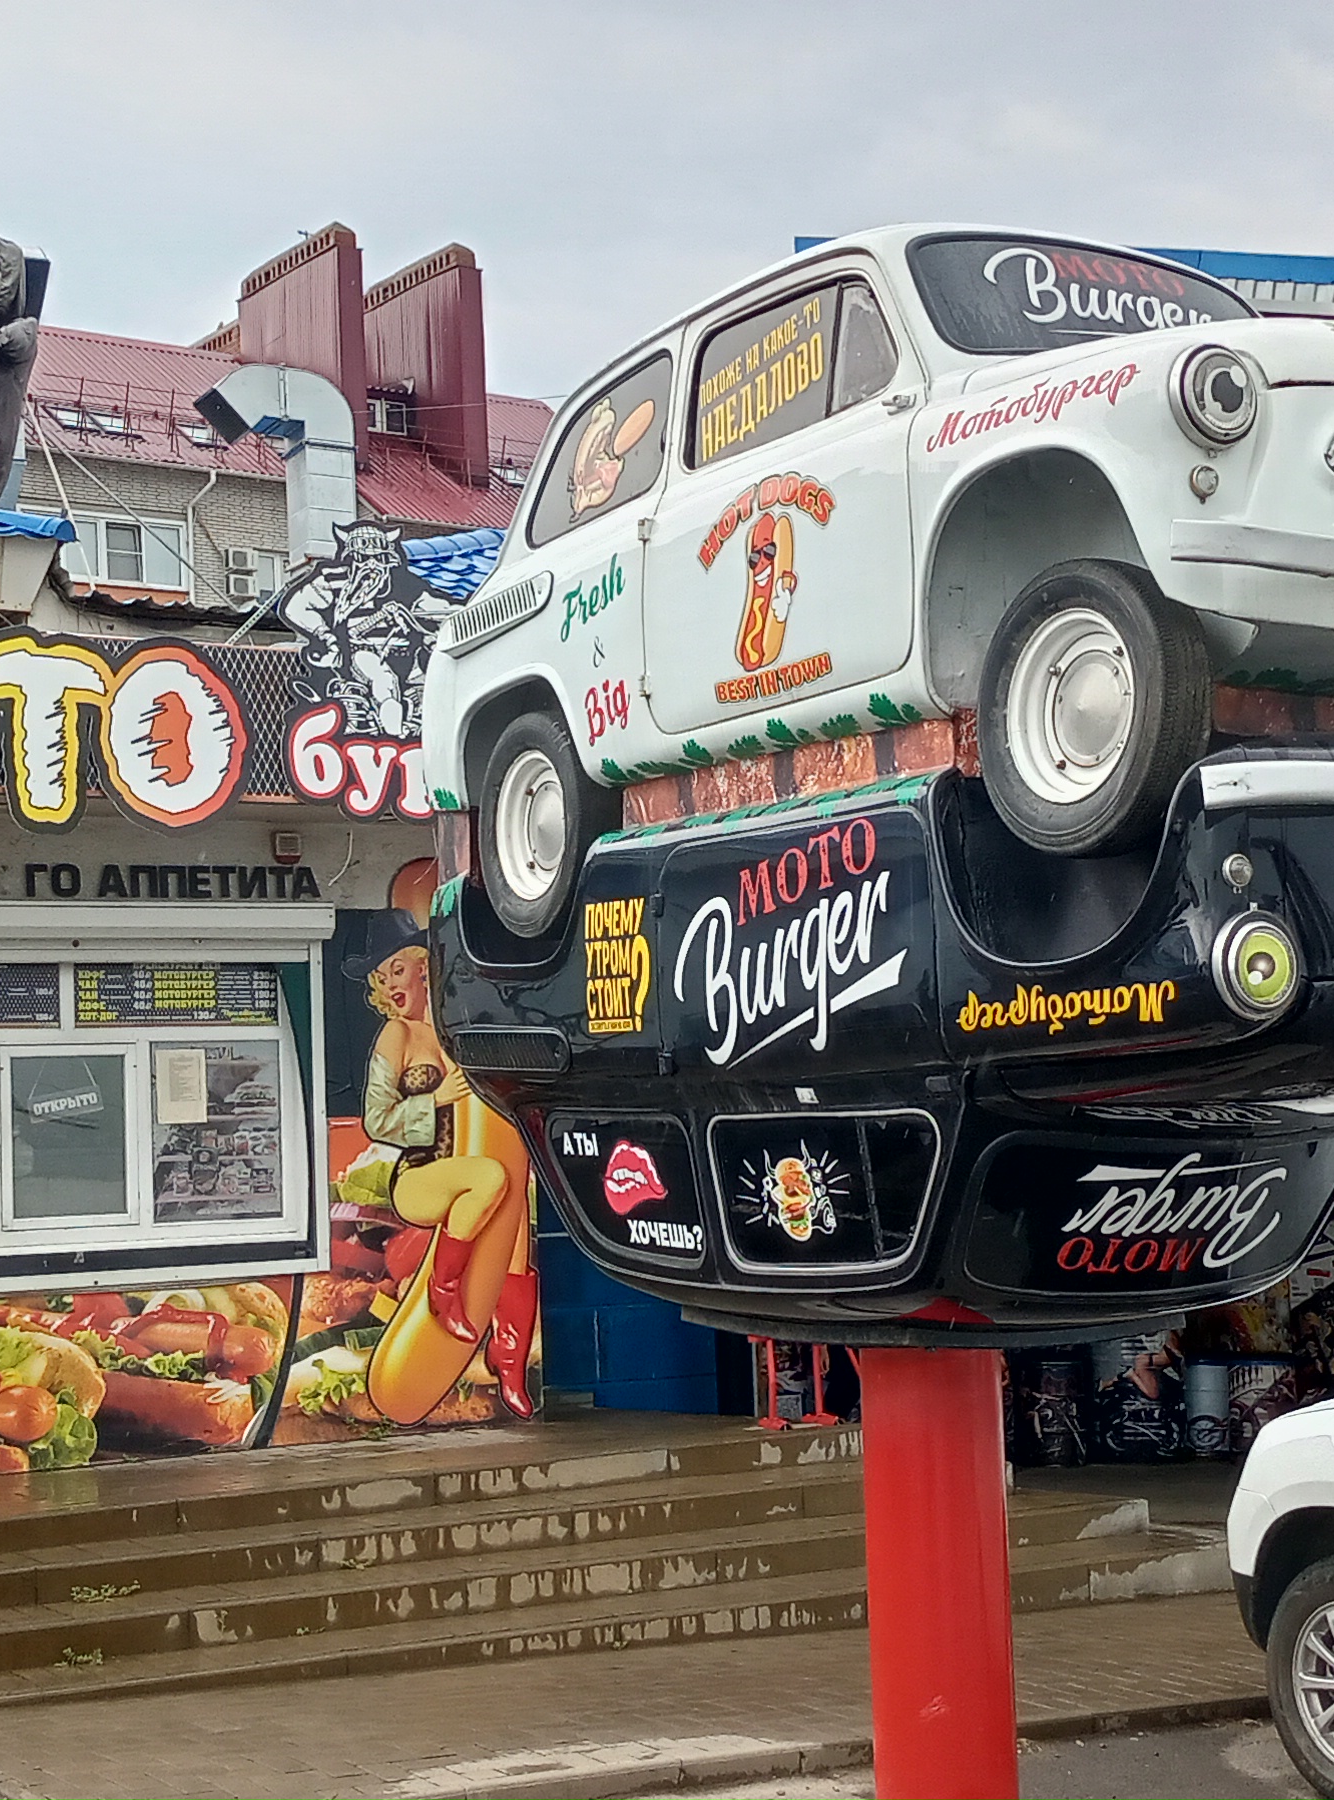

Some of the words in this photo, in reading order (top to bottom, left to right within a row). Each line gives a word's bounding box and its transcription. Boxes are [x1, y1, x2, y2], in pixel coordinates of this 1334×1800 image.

[982, 248, 1212, 329] Burger
[1051, 252, 1185, 297] MOTO
[700, 356, 742, 410] ПОХОЖЕ
[746, 343, 760, 375] НА
[763, 297, 821, 362] КАКОЕ-ТО
[701, 332, 823, 462] НАЕДАЛОВО
[926, 363, 1141, 453] Мотобургер
[698, 484, 755, 571] HOT
[758, 473, 835, 526] DOGS
[561, 553, 626, 642] Fresh
[593, 636, 606, 668] &
[716, 676, 757, 704] BEST
[760, 670, 779, 697] IN
[779, 652, 832, 691] TOWN
[585, 679, 631, 747] Big
[97, 864, 322, 899] АППЕТИТА
[737, 817, 877, 926] MOTO
[584, 898, 645, 939] ПОЧЕМУ
[585, 938, 631, 978] УТРОМ
[673, 871, 890, 1065] Burger
[586, 977, 631, 1019] СТОИТ
[956, 980, 1175, 1035] Мотобургер
[32, 1093, 98, 1117] ОТКРЫТО
[563, 1131, 575, 1155] А
[574, 1132, 599, 1156] ТЫ
[627, 1218, 703, 1251] ХОЧЕШЬ?
[1061, 1152, 1287, 1268] Burger
[1056, 1236, 1204, 1274] MOTO
